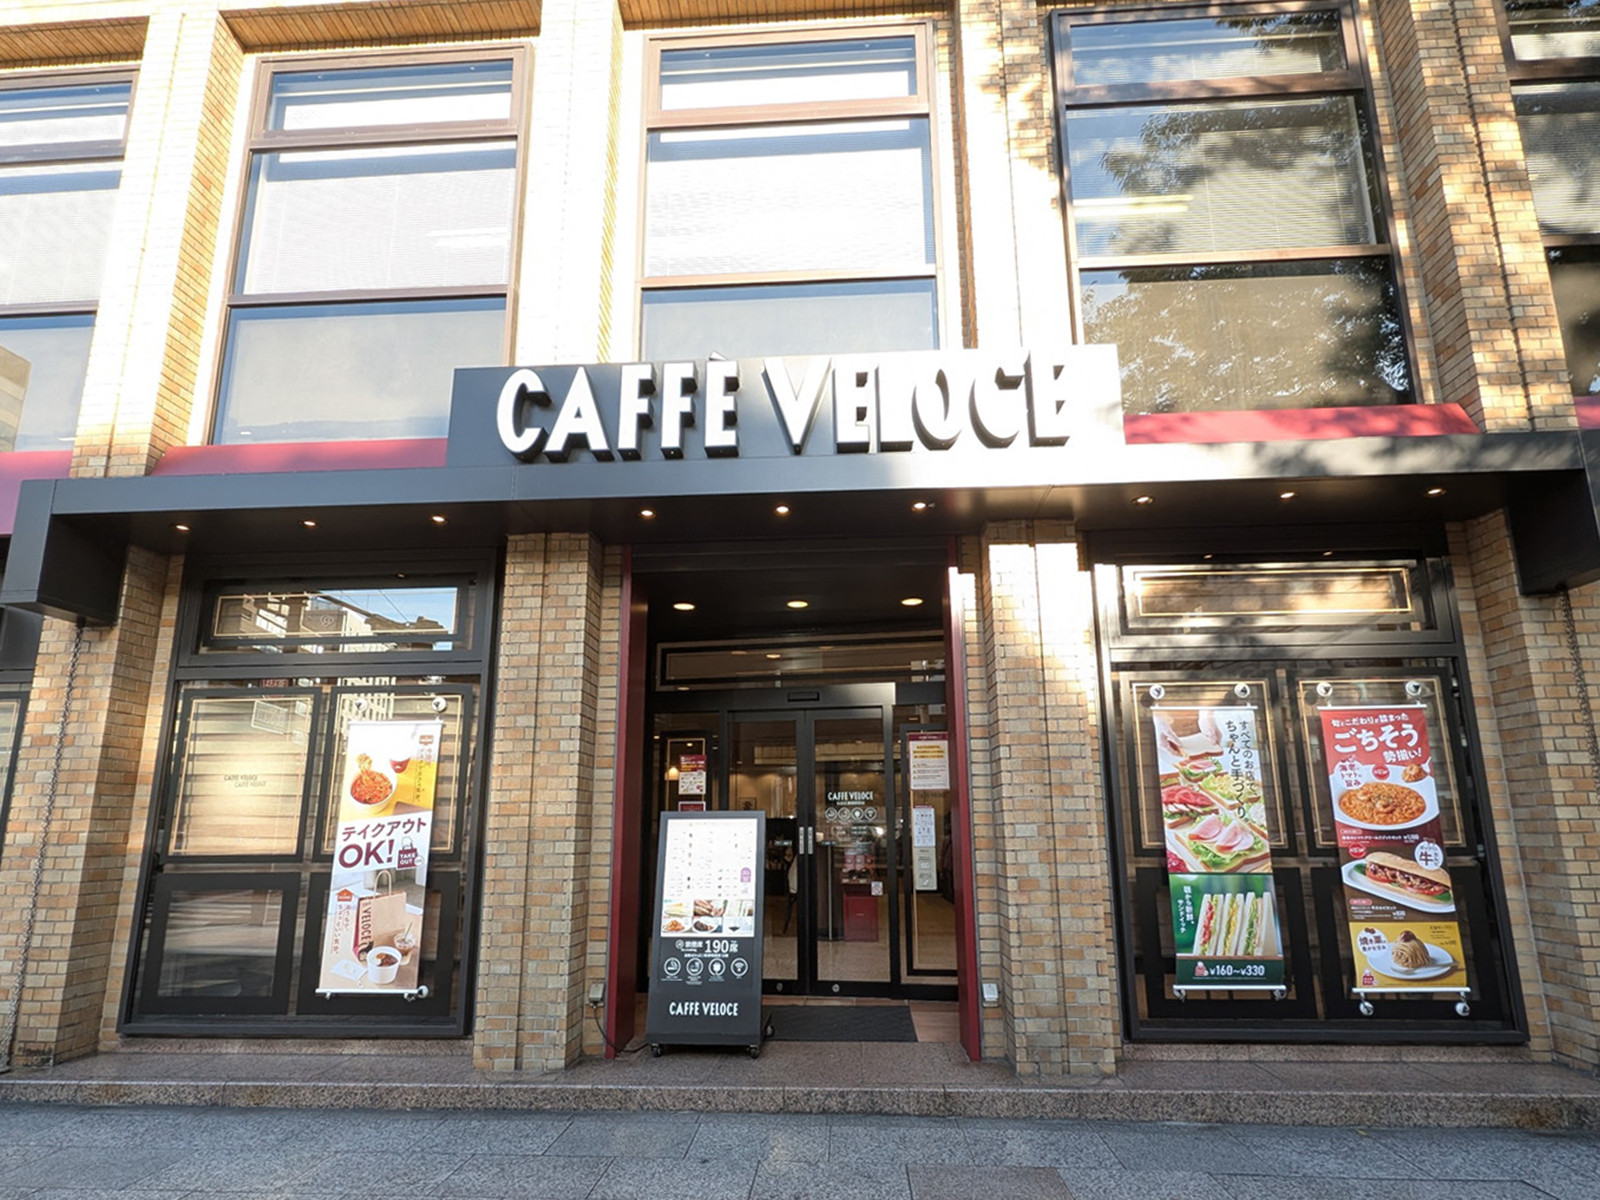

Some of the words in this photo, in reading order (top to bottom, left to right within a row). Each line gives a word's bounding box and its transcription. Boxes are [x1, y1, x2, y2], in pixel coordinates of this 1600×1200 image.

[762, 351, 1071, 456] VELOCE
[1334, 723, 1419, 753] ごちそう
[342, 817, 427, 842] テイクアウト
[338, 839, 395, 868] OK!
[361, 906, 372, 941] VELOCE
[702, 1002, 739, 1017] VELOCE
